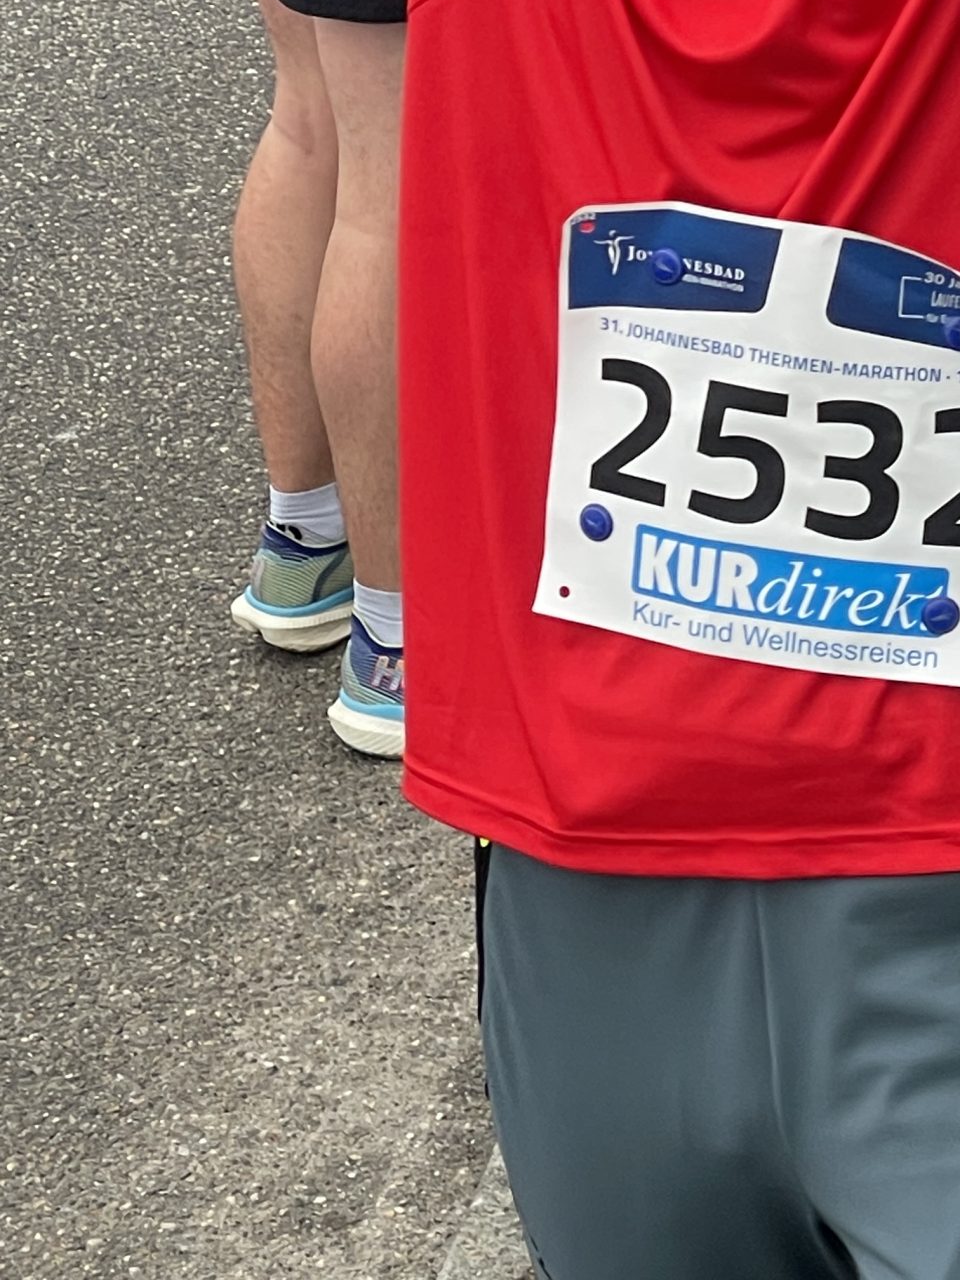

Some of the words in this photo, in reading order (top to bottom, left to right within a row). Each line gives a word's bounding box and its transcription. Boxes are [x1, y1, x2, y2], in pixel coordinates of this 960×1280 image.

[627, 245, 746, 281] JONESBAD
[924, 271, 946, 286] 30
[600, 317, 624, 335] 31.
[626, 322, 745, 359] JOHANNESBAD
[749, 347, 941, 382] THERMEN-MARATHON
[632, 601, 681, 627] Kur-
[687, 618, 733, 643] und
[742, 623, 939, 668] Wellnessreisen
